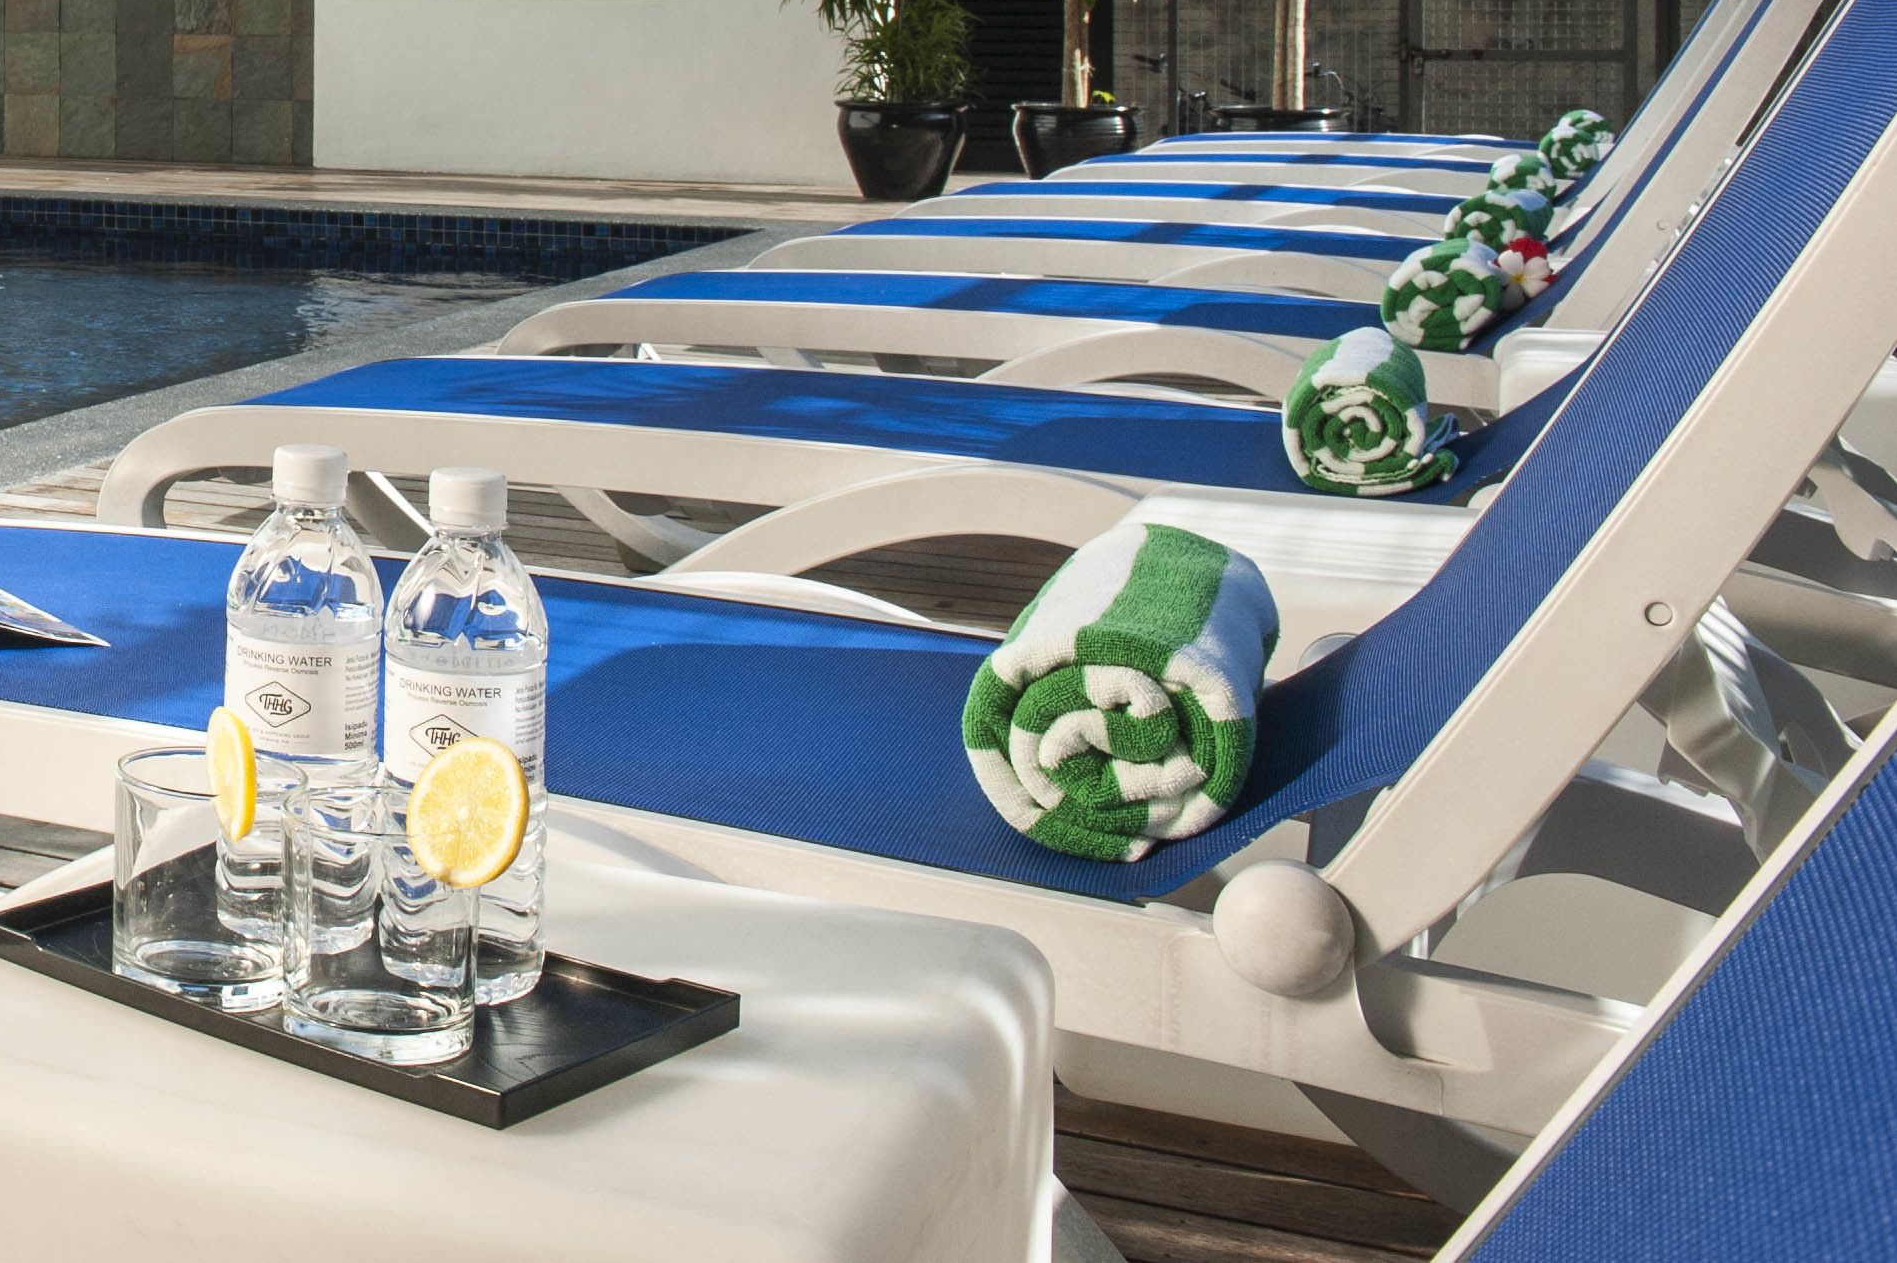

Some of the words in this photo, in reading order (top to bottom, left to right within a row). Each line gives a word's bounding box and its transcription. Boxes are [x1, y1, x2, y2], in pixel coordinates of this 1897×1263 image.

[238, 646, 284, 665] DRINKING
[288, 655, 333, 667] WATER
[400, 678, 452, 697] DRINKING
[455, 687, 502, 699] WATER
[259, 693, 293, 716] THHG
